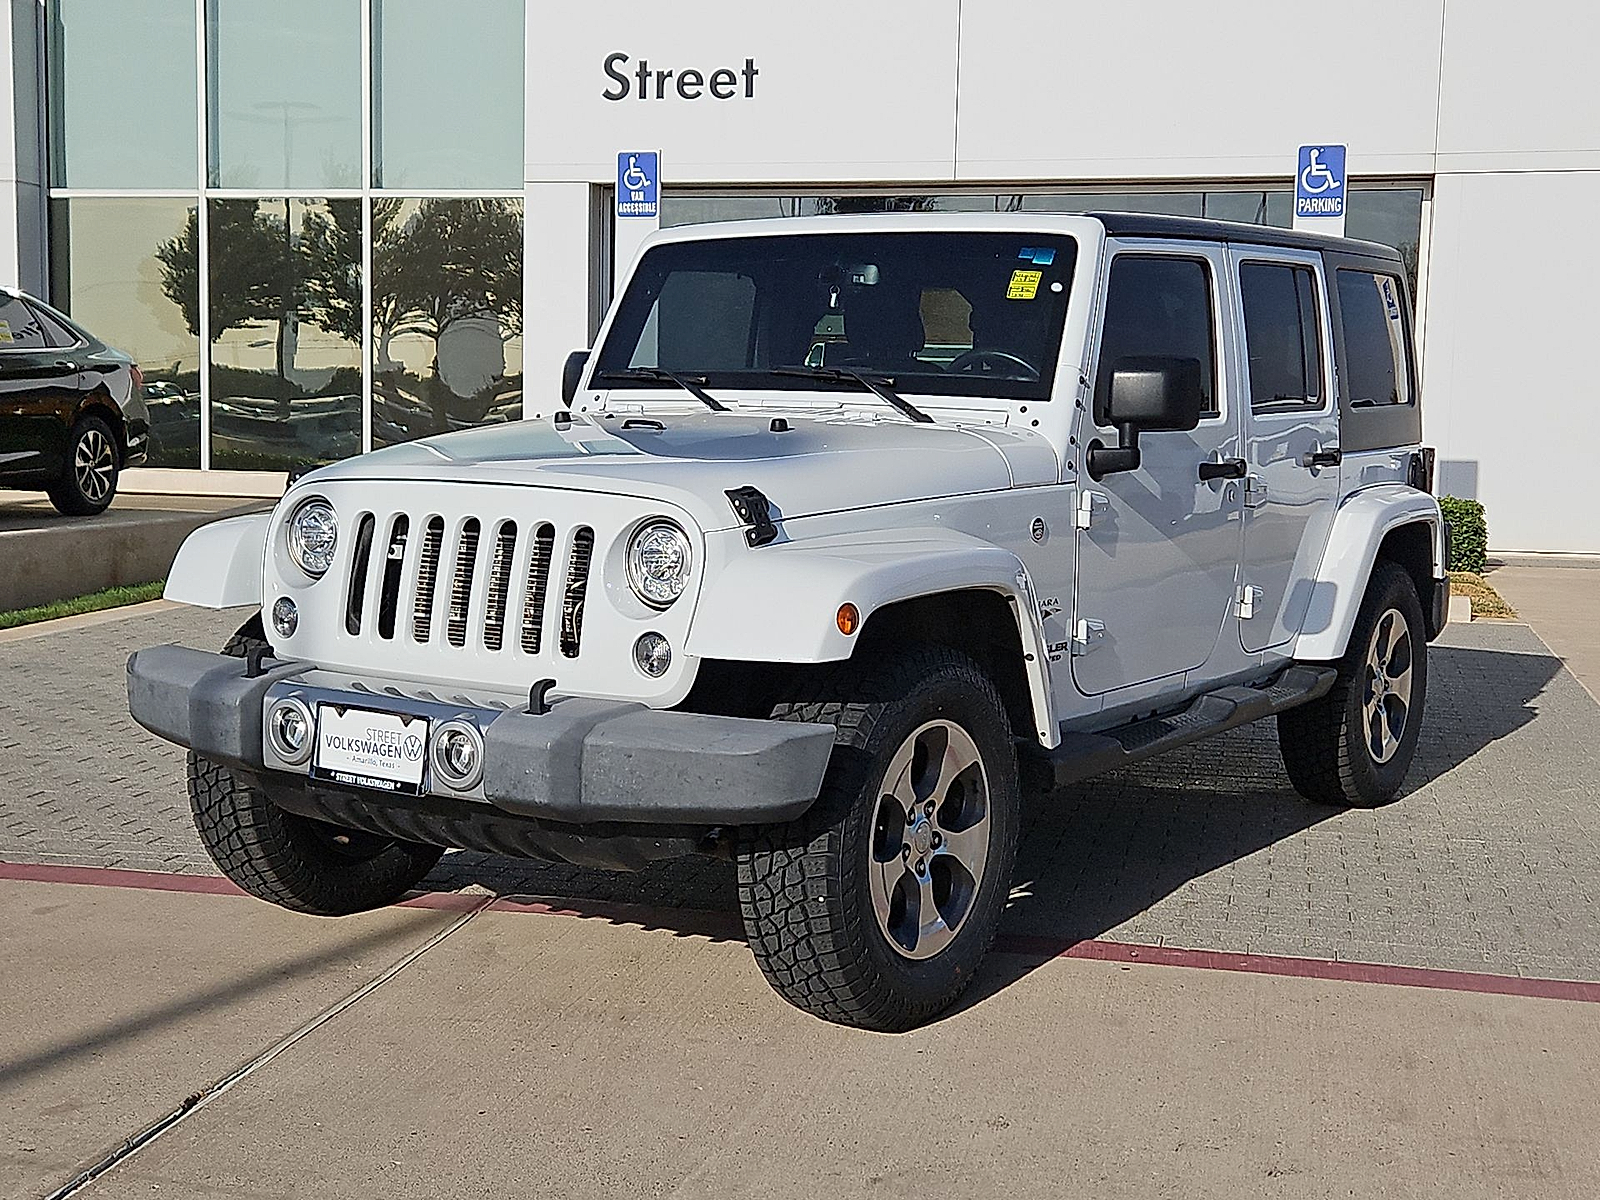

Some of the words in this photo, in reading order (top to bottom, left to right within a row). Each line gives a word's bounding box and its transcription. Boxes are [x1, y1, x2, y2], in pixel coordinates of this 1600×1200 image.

[602, 52, 759, 101] Street
[618, 202, 657, 213] ACCESSIBLE
[1298, 197, 1342, 213] PARKING
[366, 727, 402, 745] STREET
[325, 734, 402, 760] VOLKSWAGEN
[379, 759, 396, 769] Texas
[335, 772, 356, 784] STREET
